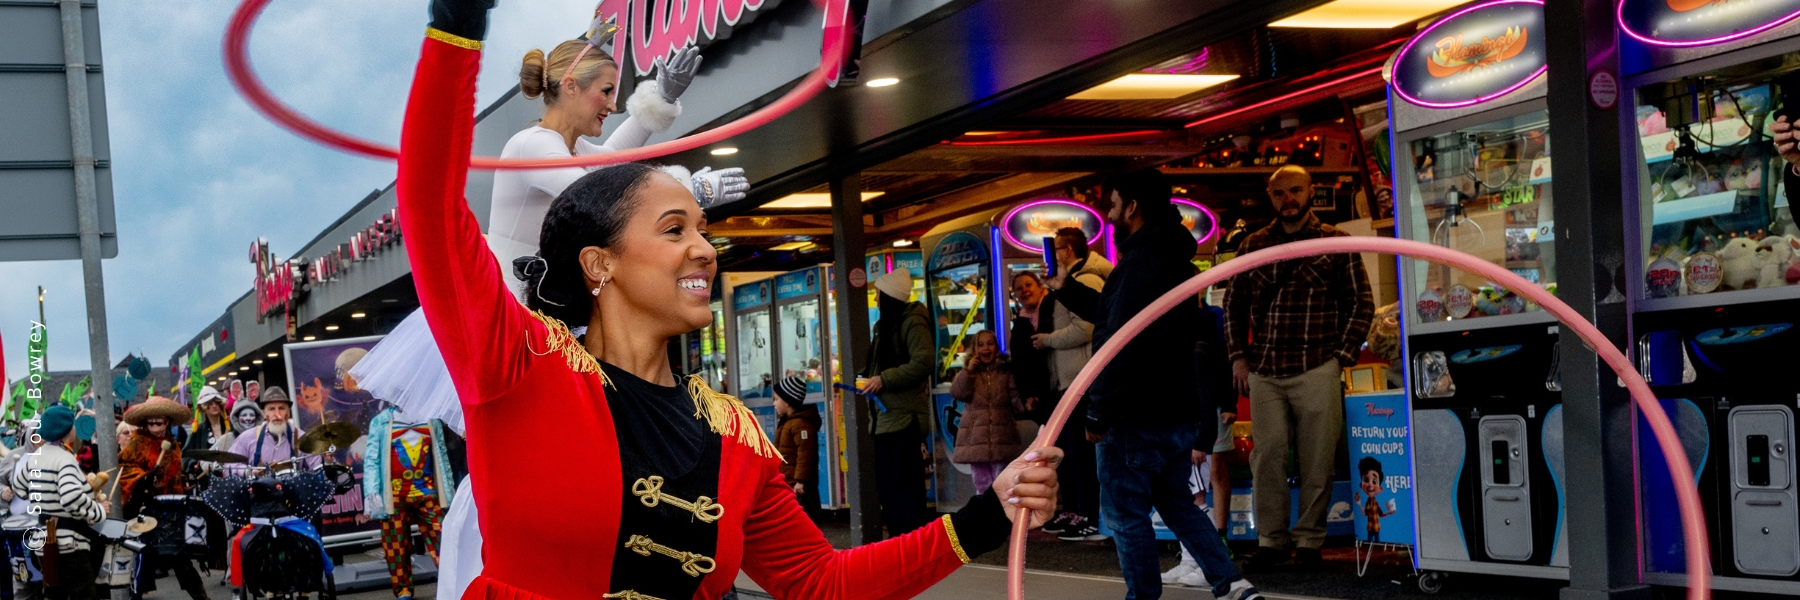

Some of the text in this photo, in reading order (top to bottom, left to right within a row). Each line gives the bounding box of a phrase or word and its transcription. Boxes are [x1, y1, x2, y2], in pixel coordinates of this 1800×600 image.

[1435, 33, 1515, 67] Flamingo
[896, 260, 919, 269] PRIZE
[1351, 426, 1385, 439] RETURN
[1361, 442, 1404, 456] COIN CUPS
